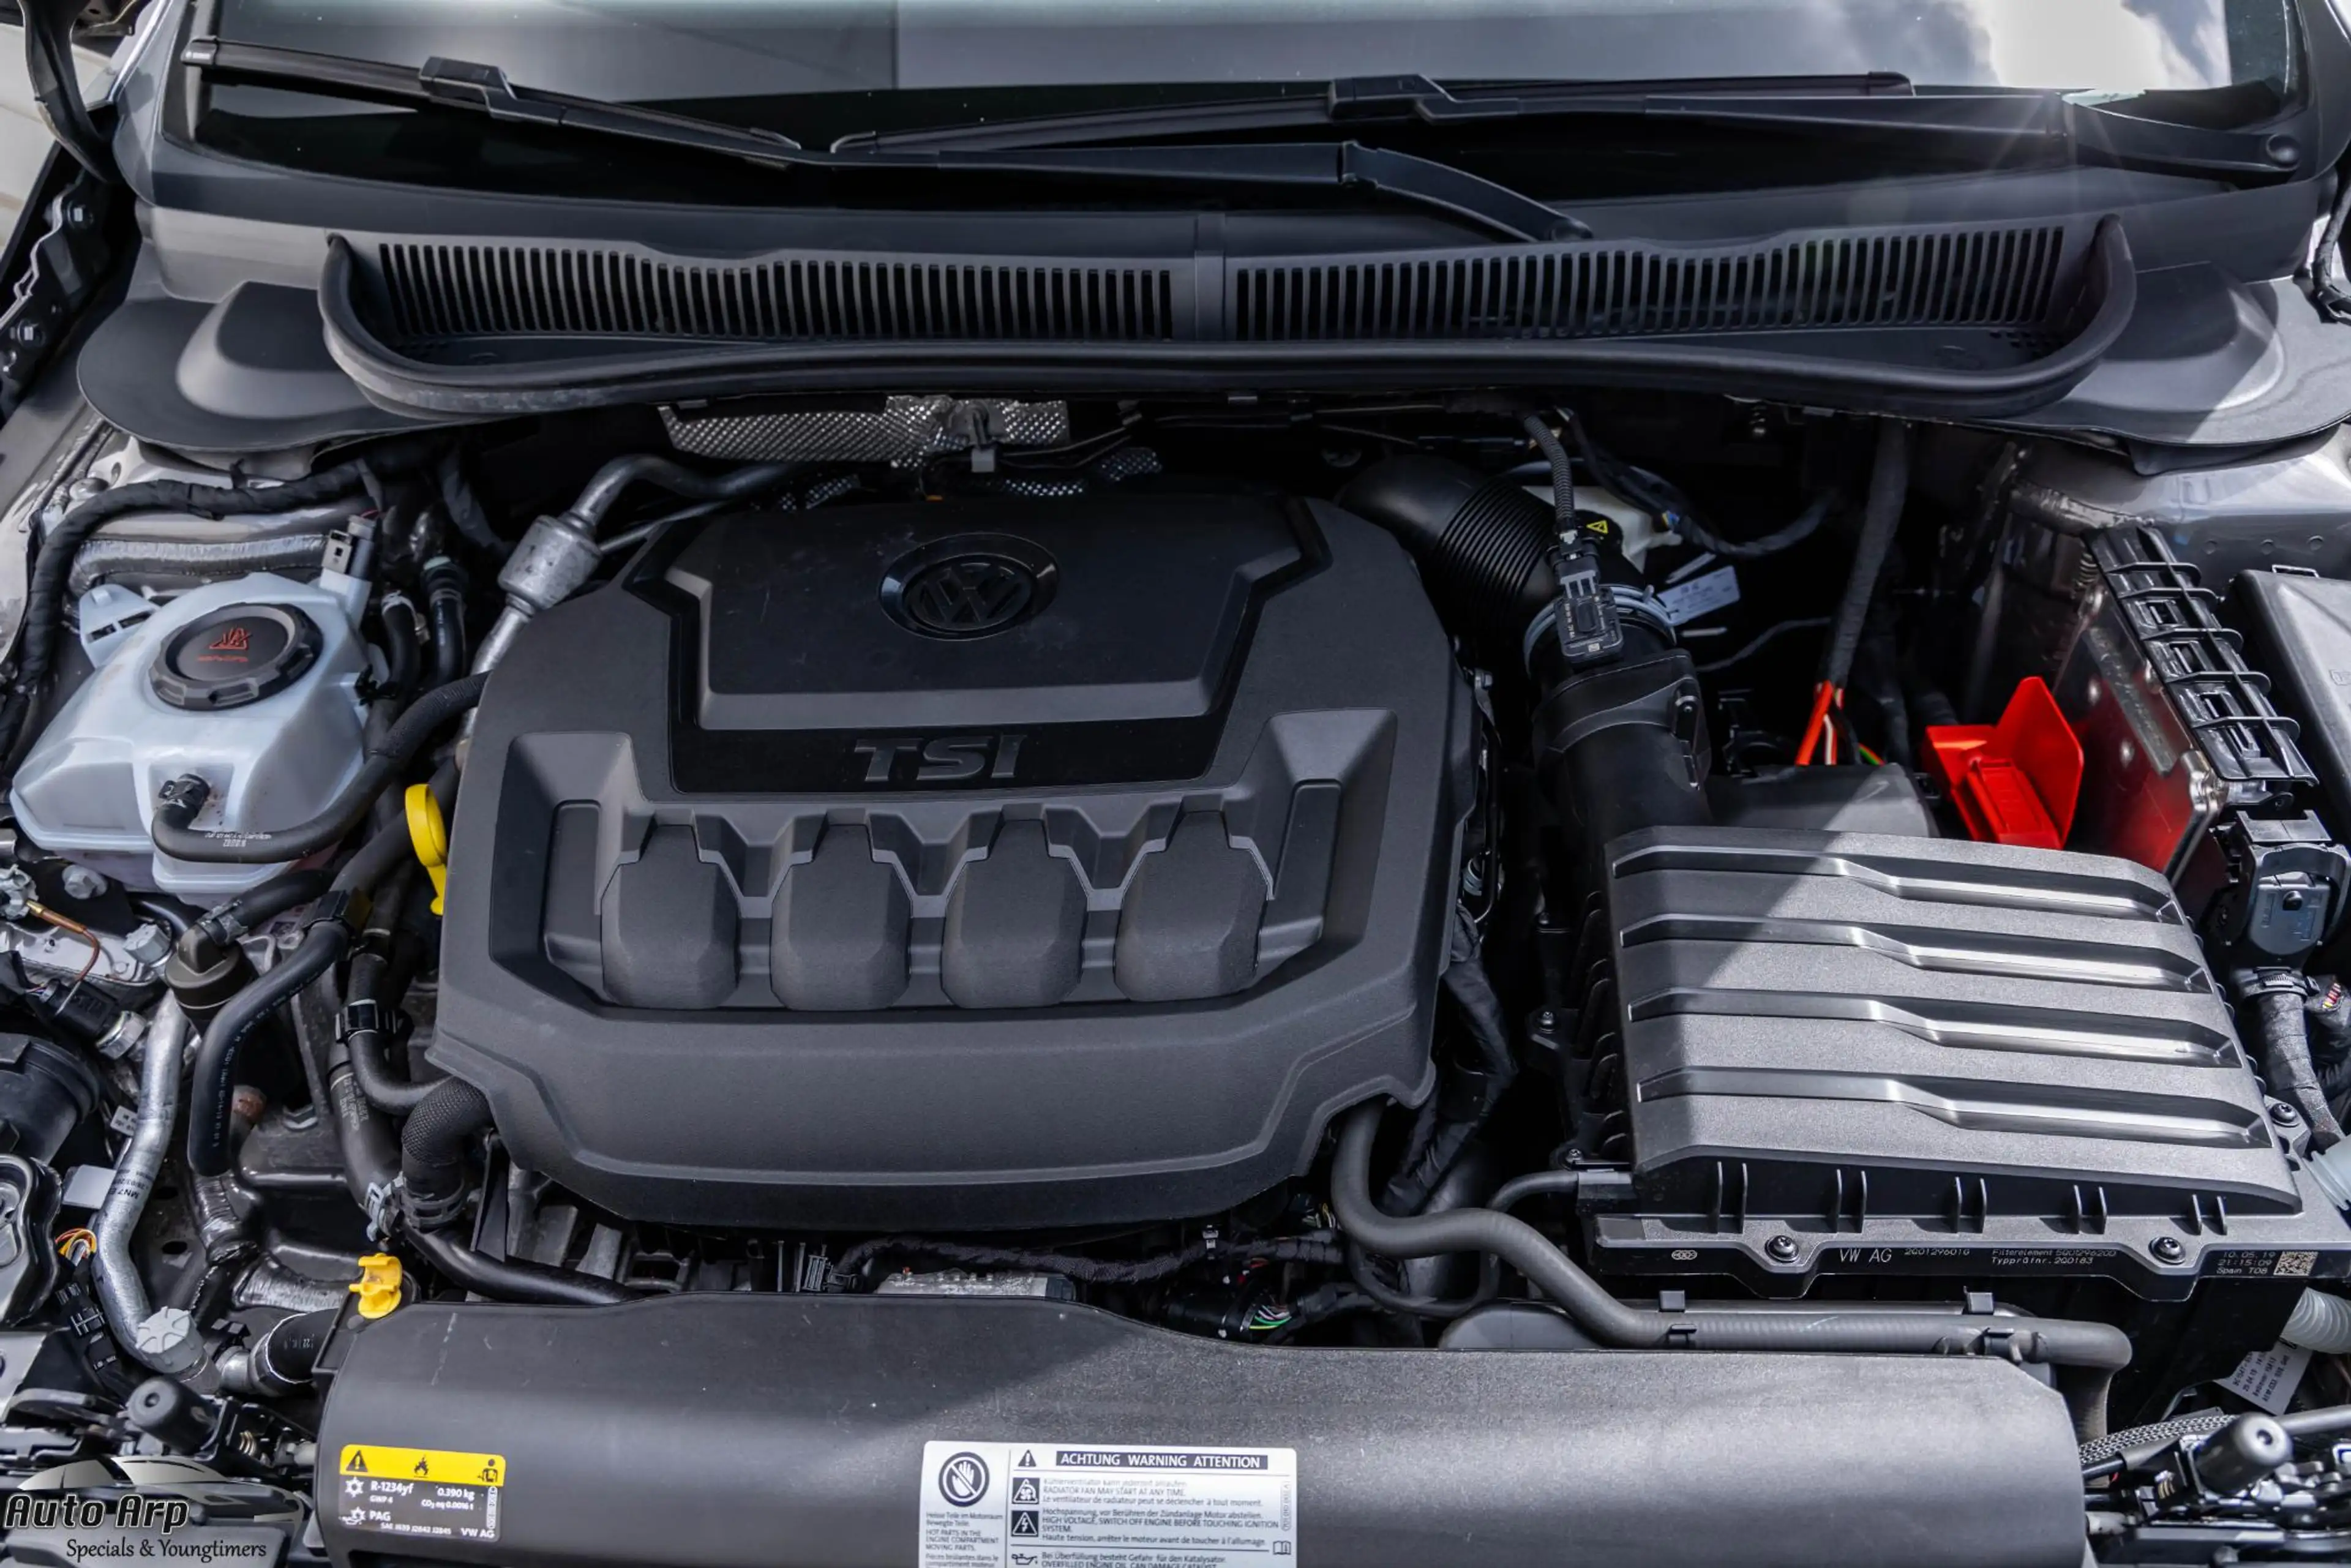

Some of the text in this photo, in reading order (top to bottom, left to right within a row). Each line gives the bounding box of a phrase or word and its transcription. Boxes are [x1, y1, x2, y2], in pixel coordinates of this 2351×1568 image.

[855, 733, 1029, 782] TSI
[1839, 1248, 1861, 1263] VW
[1869, 1248, 1892, 1262] AG
[2216, 1266, 2243, 1275] Spain
[1060, 1453, 1261, 1469] ACHTUNG WARNING ATTENTION
[370, 1480, 475, 1501] R-1234yf 0.390 kg
[369, 1510, 391, 1521] PAG
[460, 1528, 495, 1539] VW AG
